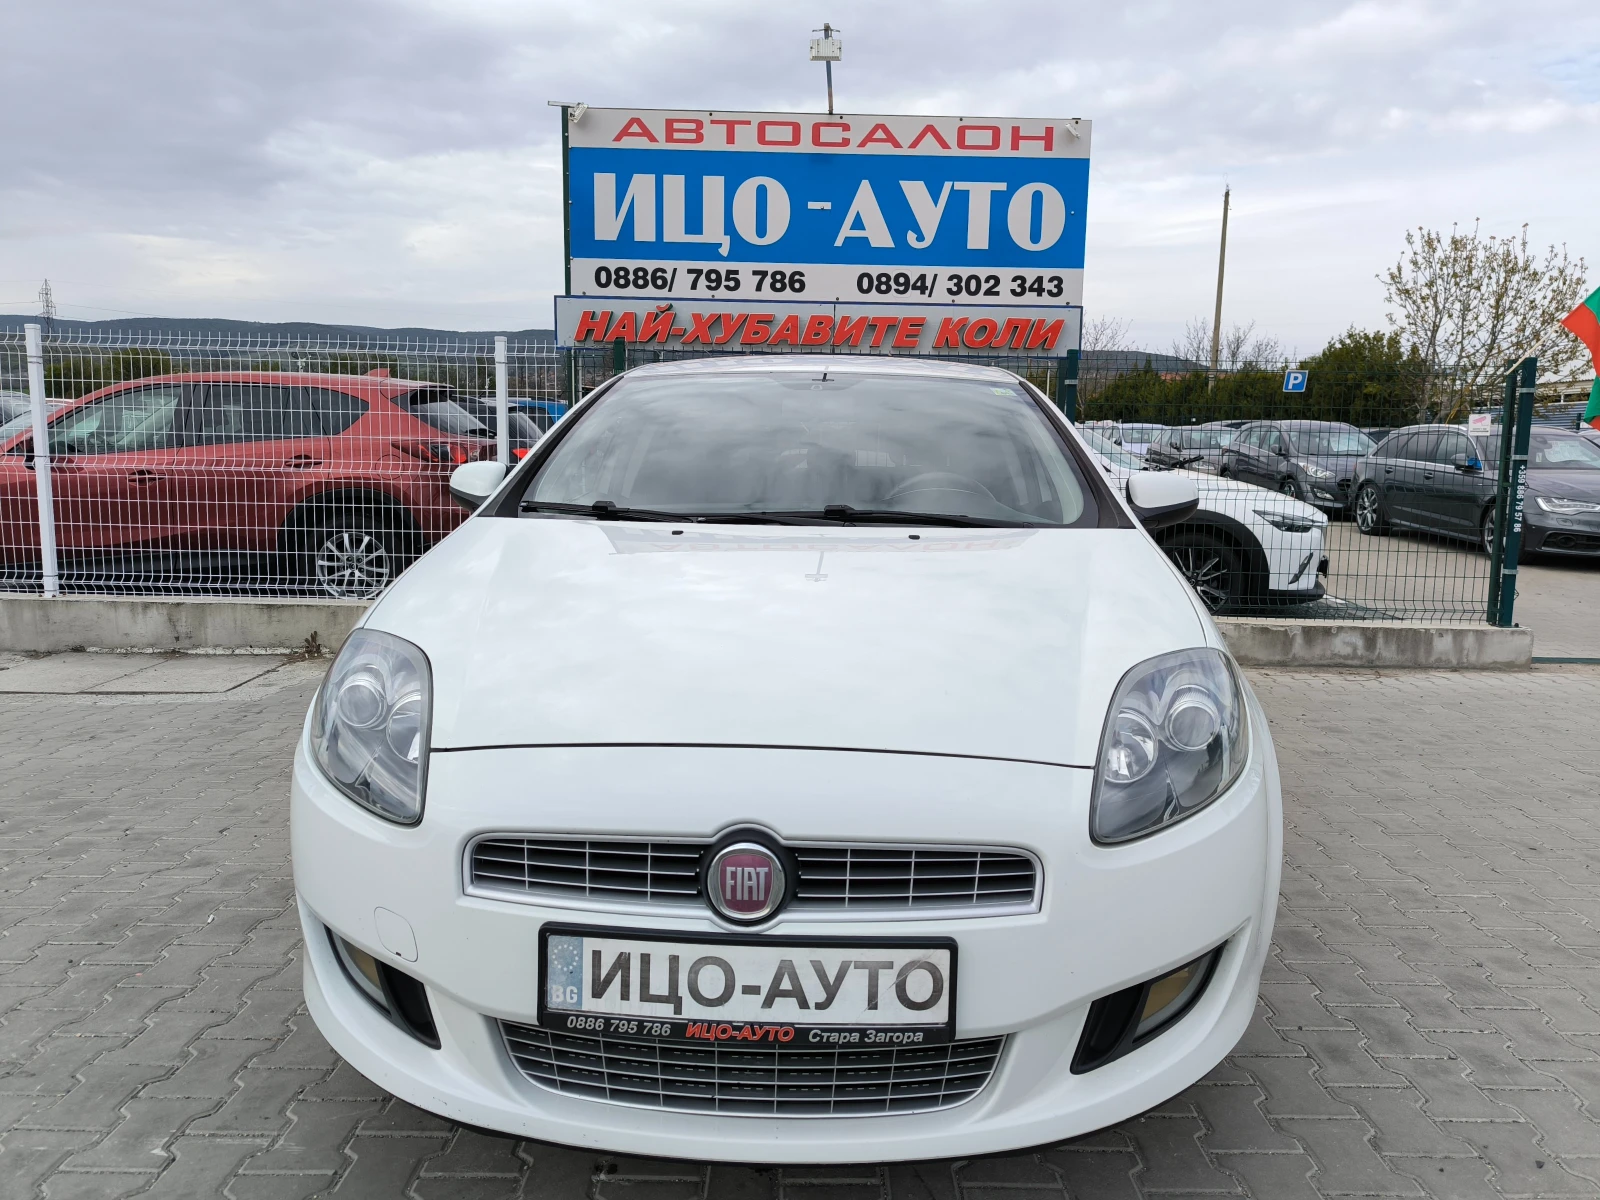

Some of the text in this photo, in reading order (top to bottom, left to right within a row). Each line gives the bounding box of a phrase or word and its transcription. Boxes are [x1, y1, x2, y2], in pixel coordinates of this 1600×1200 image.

[612, 117, 1054, 152] АВТОСАЛОН
[594, 266, 806, 293] 0886/ 795 786
[856, 272, 1064, 298] 0894/ 302 343
[573, 303, 1066, 351] НАЙ-ХУБАВИТЕ КОЛИ
[1288, 372, 1303, 390] P
[1513, 464, 1526, 533] +359 886 79 57 86
[725, 866, 770, 901] FIAT
[550, 985, 578, 1004] BG
[590, 949, 944, 1015] ИЦО-АУТО
[566, 1015, 672, 1036] 0886 795 786
[685, 1022, 795, 1042] ИЦО-АУТО
[808, 1029, 924, 1045] Стара Загора
